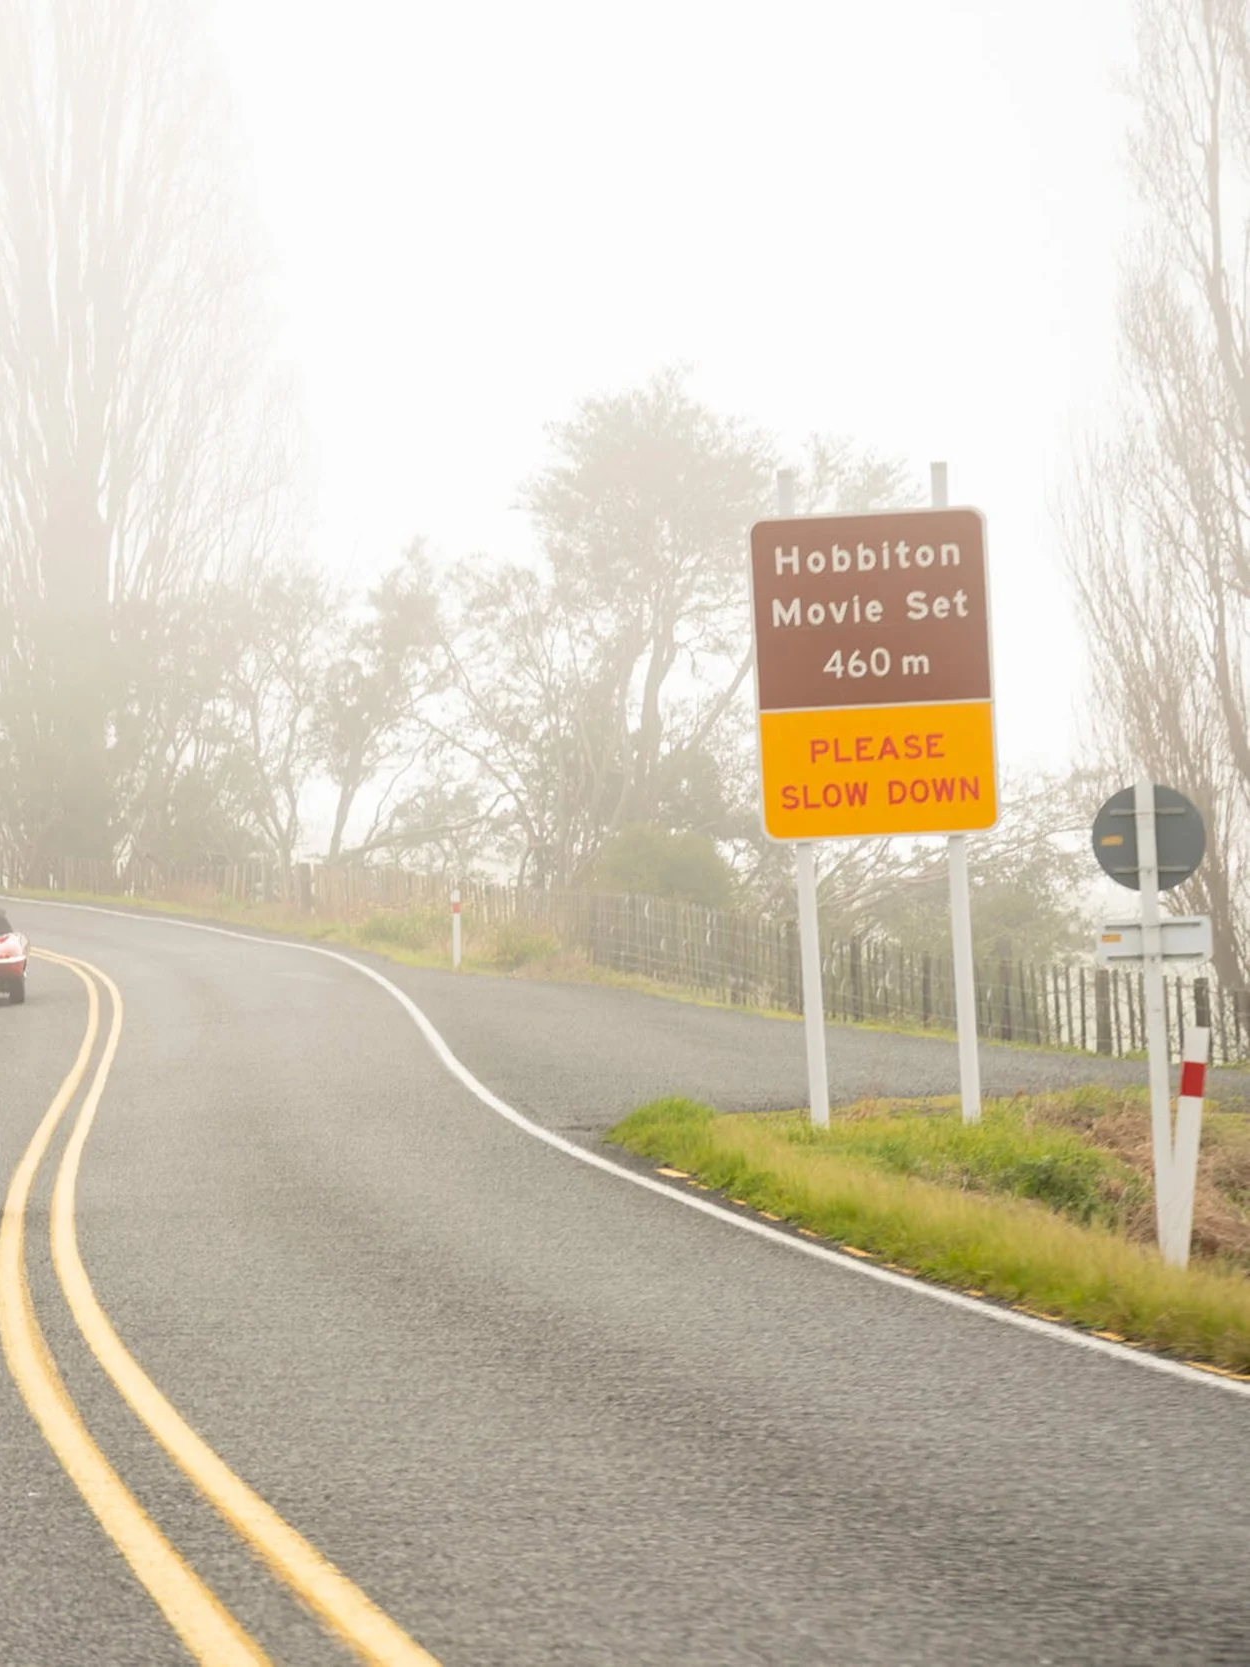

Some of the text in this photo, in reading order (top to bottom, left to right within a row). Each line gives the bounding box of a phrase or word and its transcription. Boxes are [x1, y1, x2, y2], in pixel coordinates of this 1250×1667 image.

[775, 541, 961, 575] Hobbiton
[772, 588, 969, 628] Movie Set
[823, 648, 930, 679] 460 m
[809, 733, 945, 765] PLEASE
[781, 775, 980, 811] SLOW DOWN
